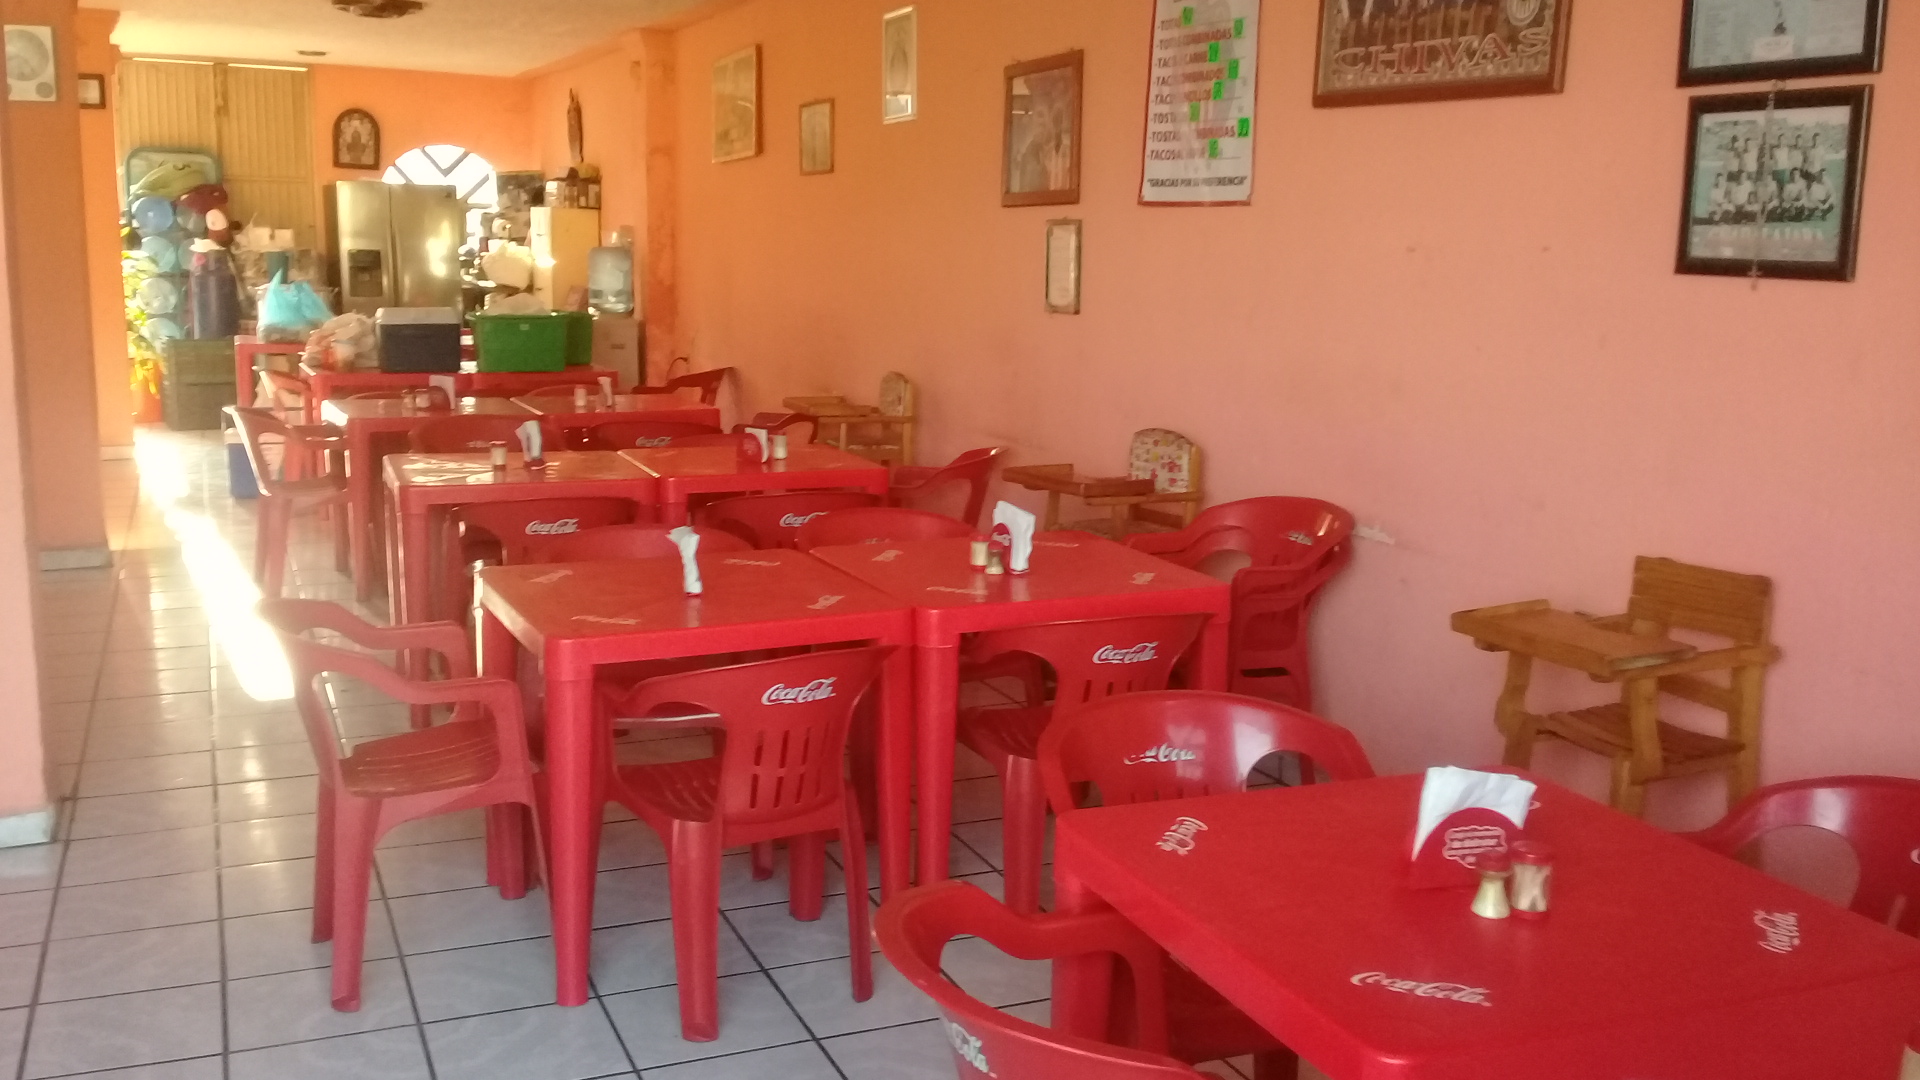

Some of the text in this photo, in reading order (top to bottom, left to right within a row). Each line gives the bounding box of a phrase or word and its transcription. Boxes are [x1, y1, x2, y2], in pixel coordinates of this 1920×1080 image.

[1334, 26, 1552, 75] CHIVAS
[1092, 641, 1159, 664] Coca-Cola
[761, 676, 838, 706] Coca-Cola
[1350, 970, 1493, 1007] Coca-Cola
